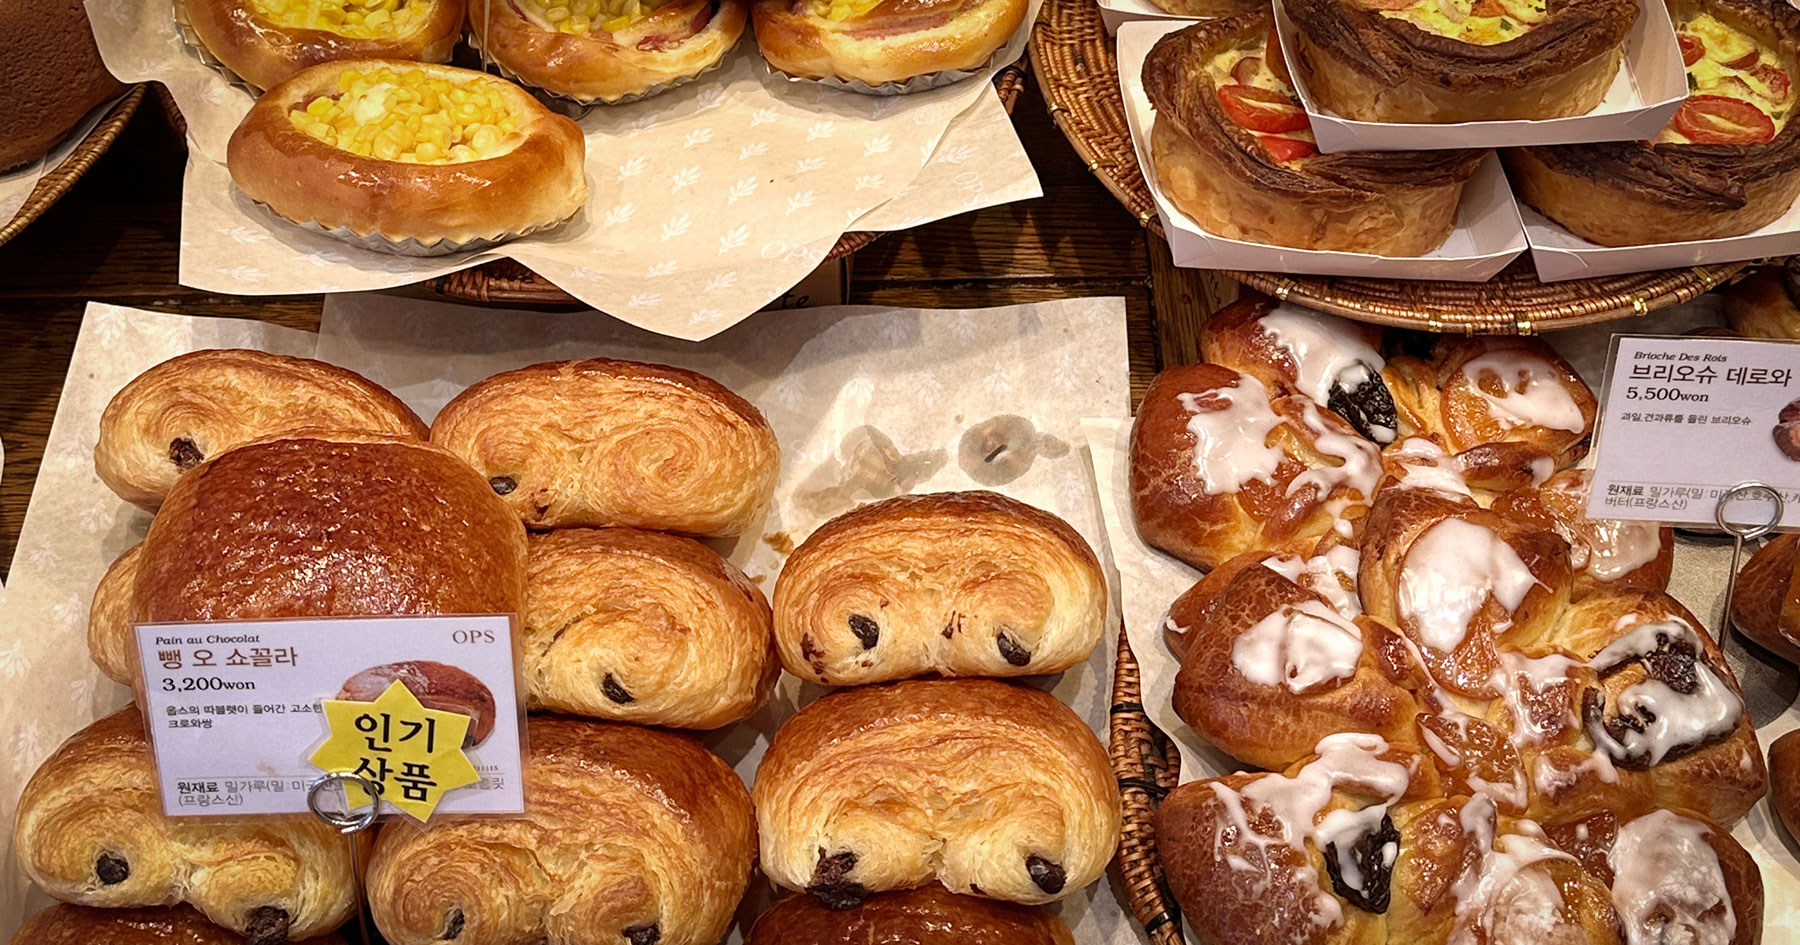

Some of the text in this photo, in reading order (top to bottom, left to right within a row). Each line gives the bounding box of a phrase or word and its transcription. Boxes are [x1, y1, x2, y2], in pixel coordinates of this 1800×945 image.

[1633, 351, 1728, 363] Brioche Des Rois
[1629, 364, 1793, 388] 브리오슈 데로와
[1626, 386, 1709, 403] 5,500won
[1711, 415, 1752, 426] 브리오슈
[1606, 483, 1644, 497] 원재료
[1604, 496, 1688, 511] 버터(프랑스산)
[155, 634, 261, 645] Pain au Chocolat
[452, 629, 495, 645] OPS
[158, 646, 298, 670] 뺑 오 쇼꼴라
[162, 676, 256, 693] 3,200won
[166, 704, 200, 717] 옵스의
[252, 703, 286, 715] 들어간
[355, 712, 435, 754] 인기
[353, 756, 438, 802] 상품
[177, 781, 220, 794] 원재료
